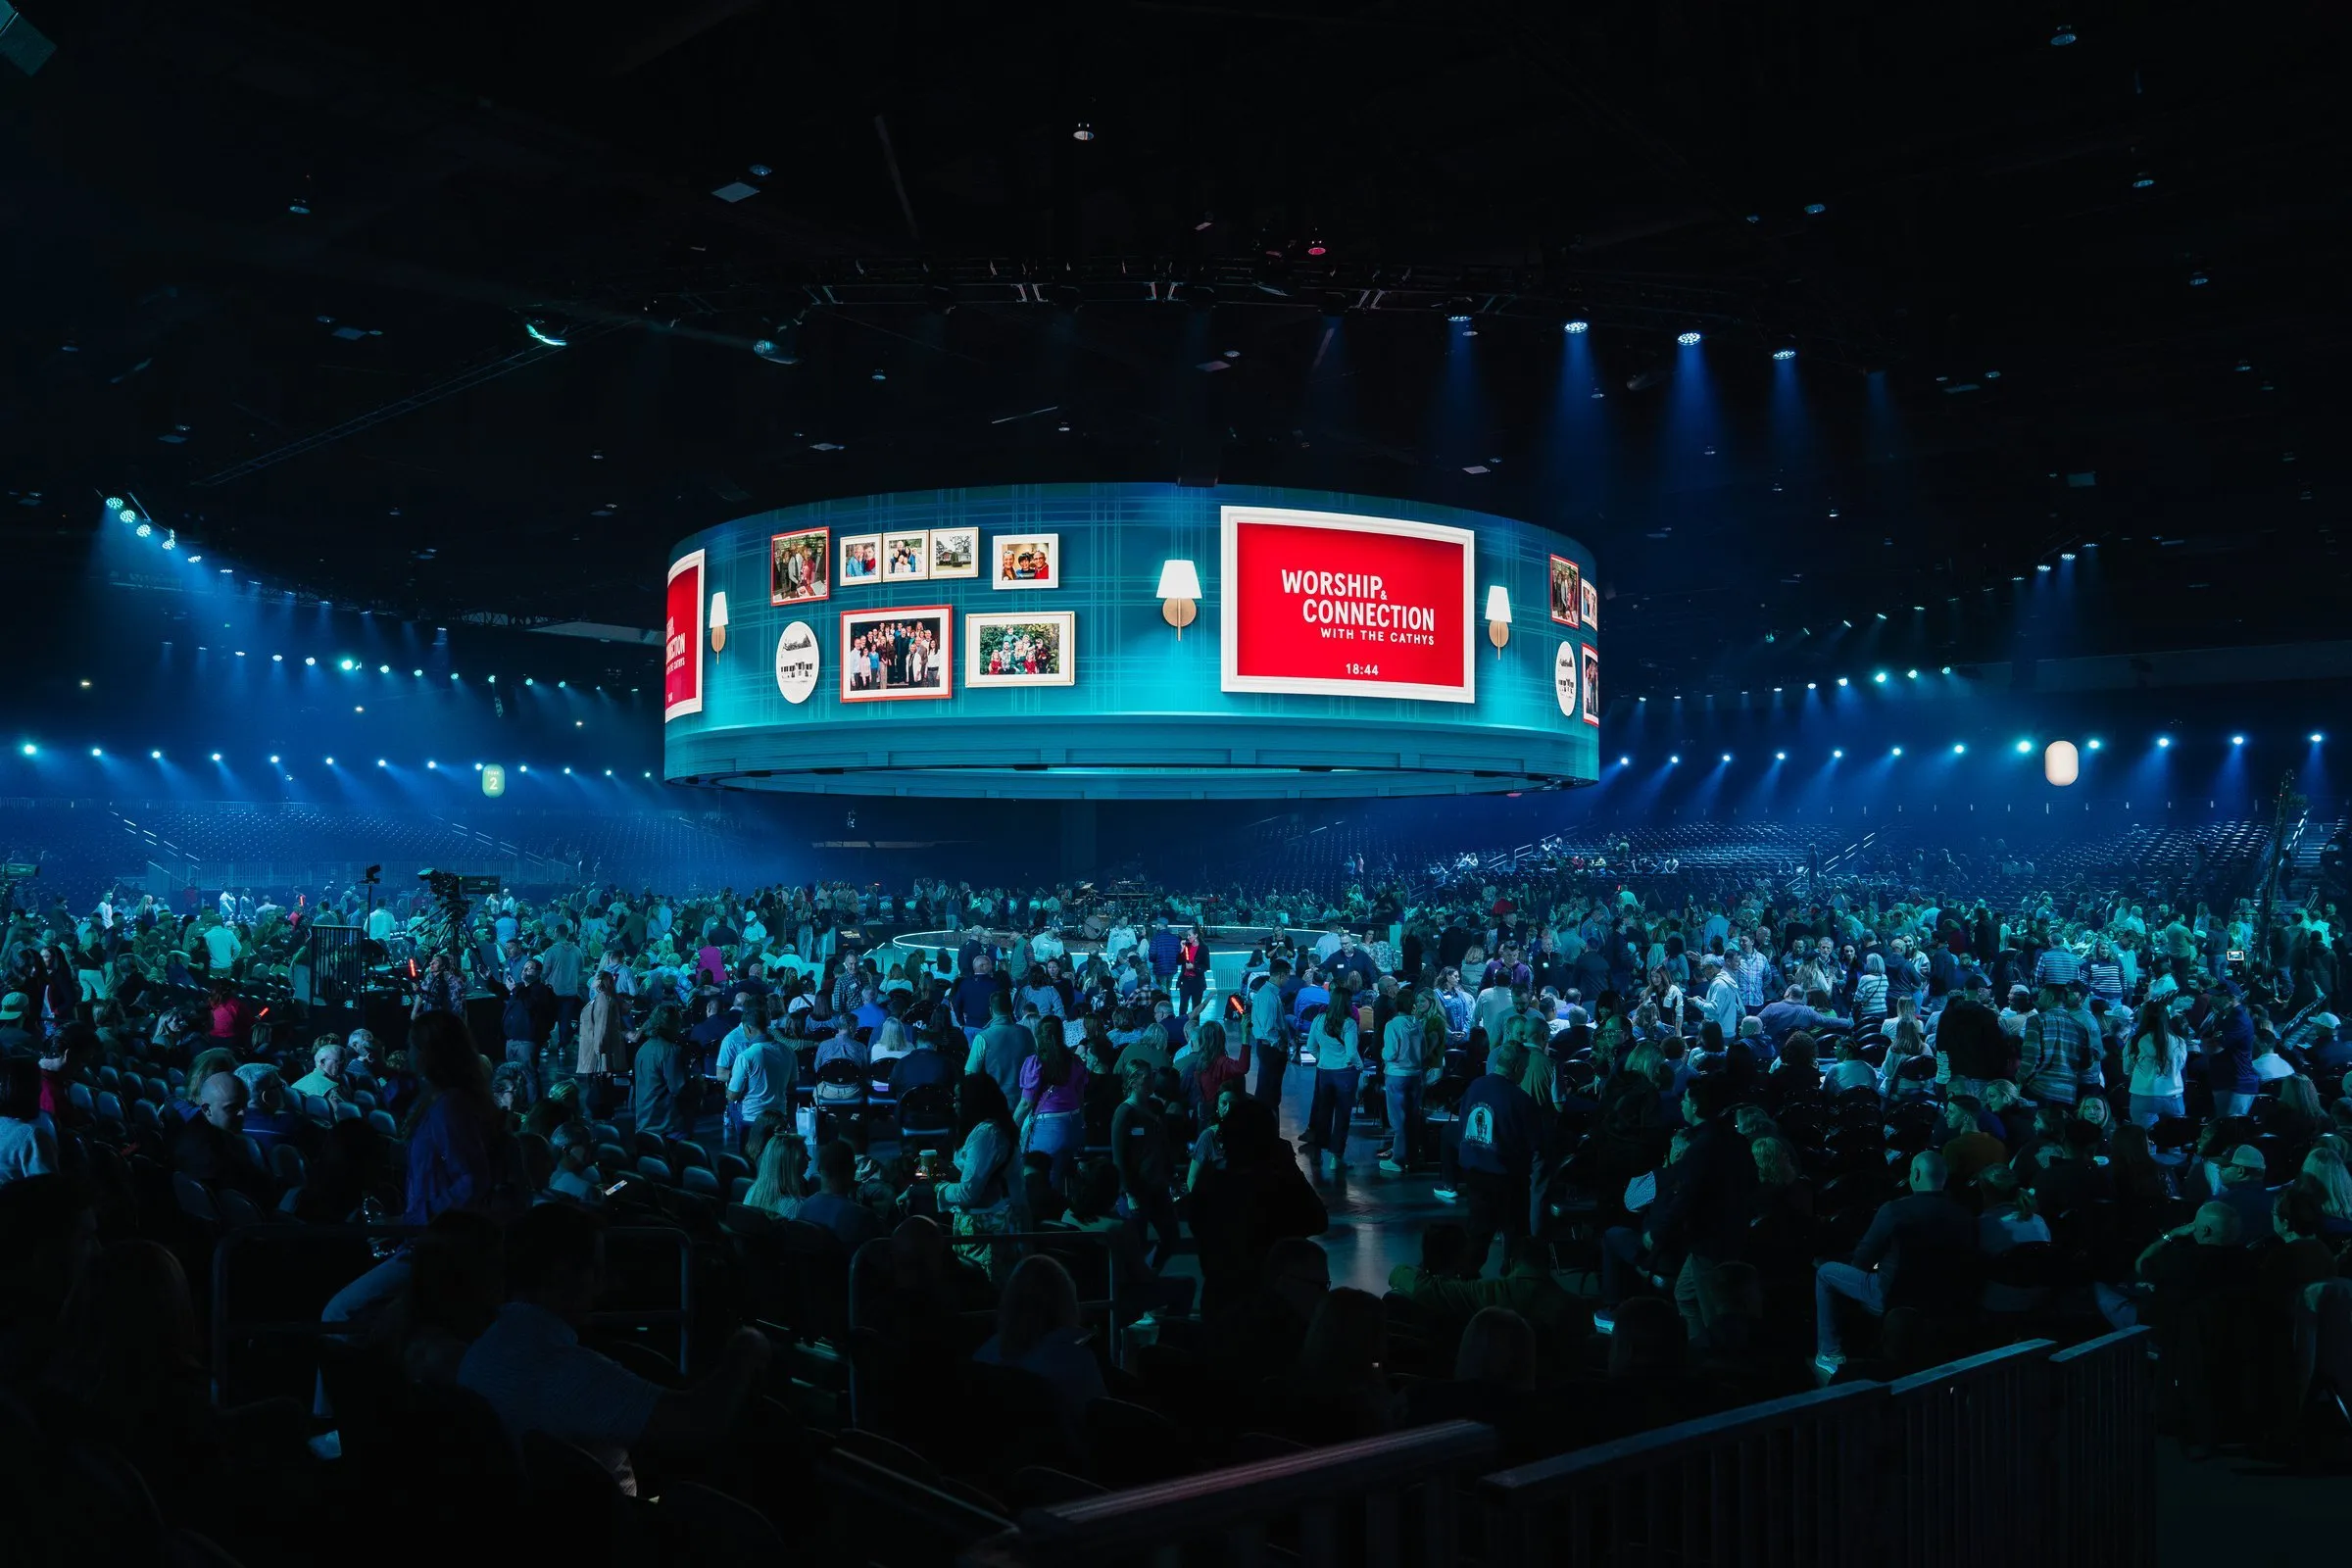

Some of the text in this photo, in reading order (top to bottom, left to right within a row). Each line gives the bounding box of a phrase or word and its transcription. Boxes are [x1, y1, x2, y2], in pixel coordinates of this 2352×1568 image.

[1281, 568, 1383, 599] WORSHIP
[1302, 599, 1435, 632] CONNECTION
[1320, 627, 1435, 646] WITH THE CATHYS
[1346, 662, 1379, 676] 18:44
[490, 777, 498, 790] 2
